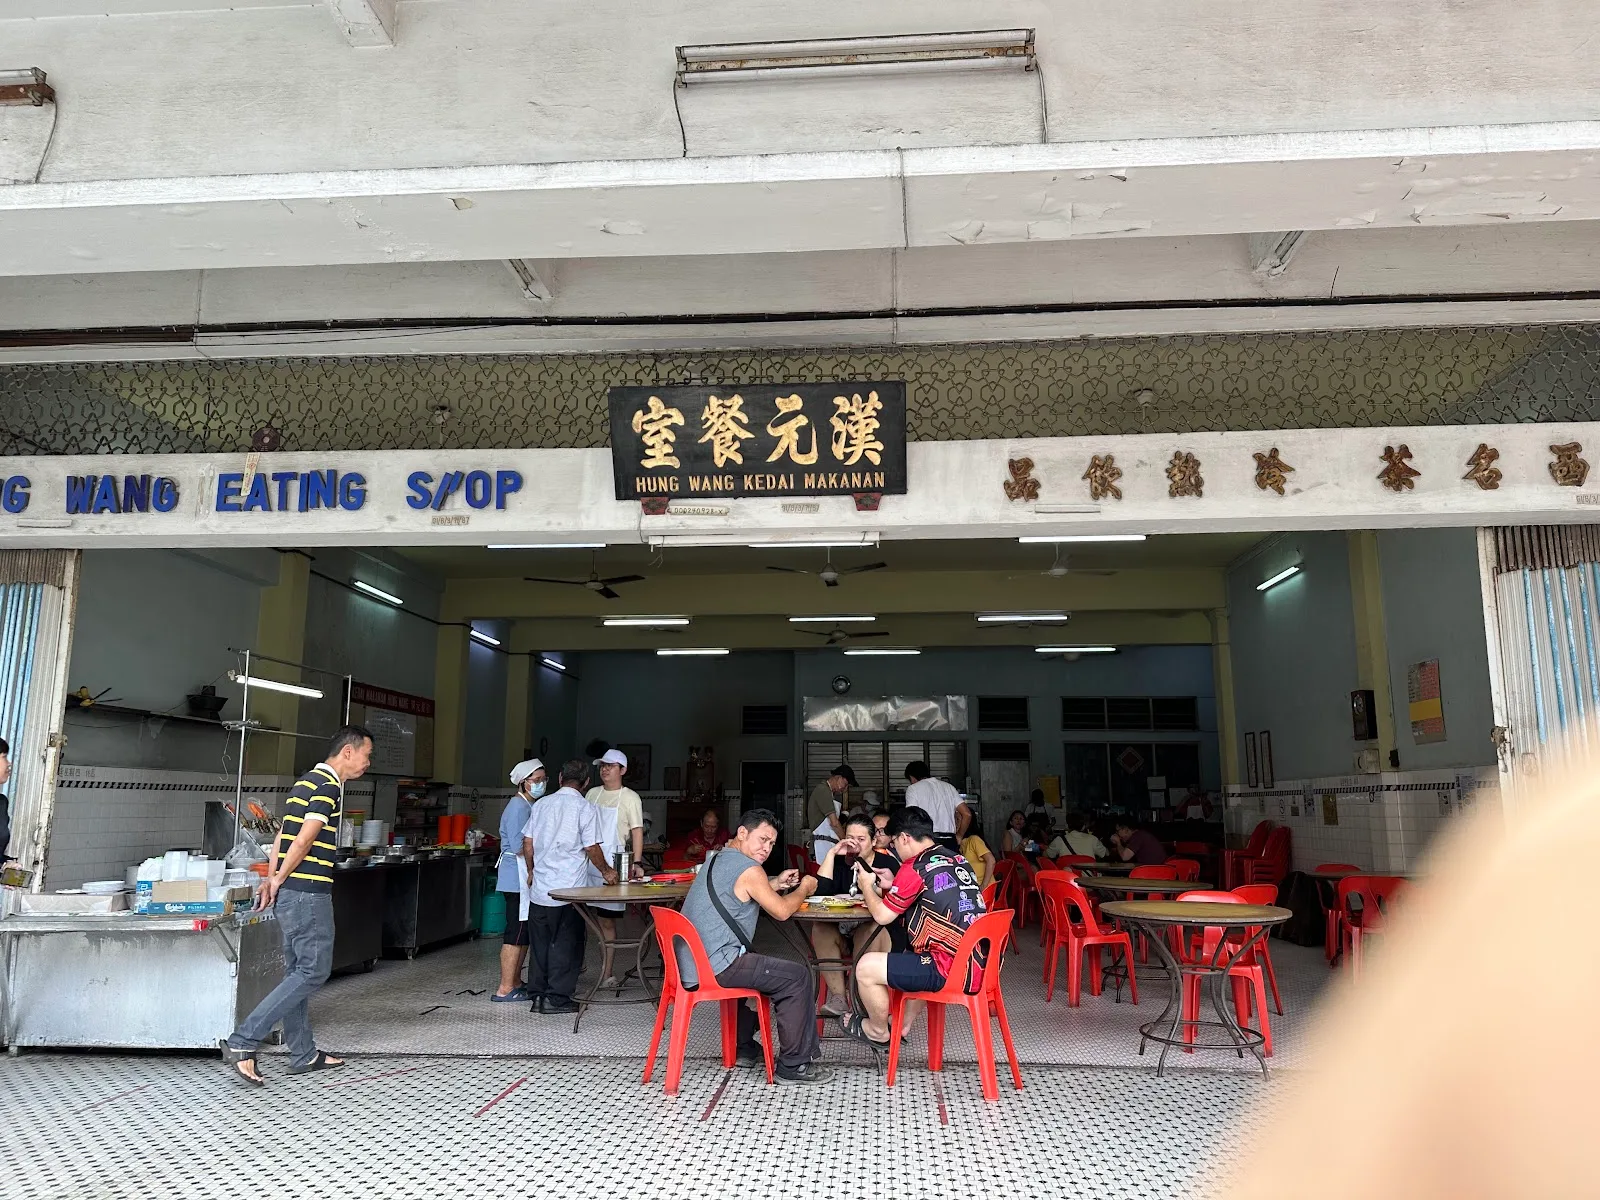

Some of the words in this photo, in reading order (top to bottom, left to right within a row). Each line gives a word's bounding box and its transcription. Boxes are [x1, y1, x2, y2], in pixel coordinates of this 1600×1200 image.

[0, 475, 31, 513] G
[66, 474, 179, 514] WANG
[216, 469, 367, 512] EATING
[636, 476, 680, 492] HUNG
[689, 475, 735, 491] WANG
[744, 474, 794, 490] KEDAI
[804, 472, 885, 488] MAKANAN
